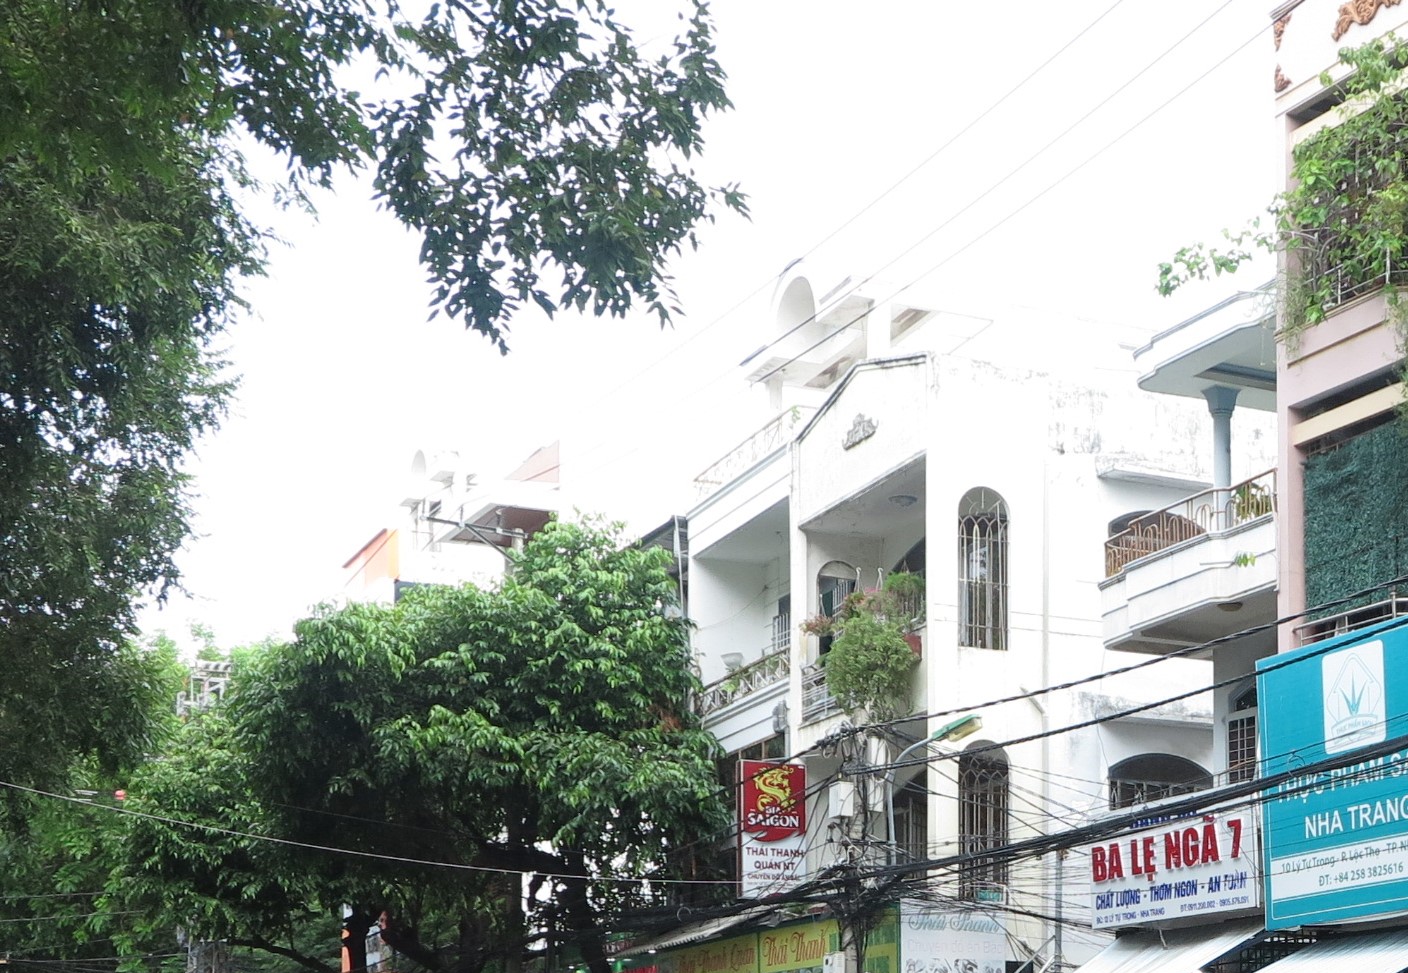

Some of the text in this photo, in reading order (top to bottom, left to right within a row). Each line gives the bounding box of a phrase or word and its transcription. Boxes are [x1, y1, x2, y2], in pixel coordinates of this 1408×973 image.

[1305, 808, 1343, 839] NHA
[1092, 843, 1123, 883] BA
[1131, 836, 1156, 882] LẸ
[1164, 815, 1219, 870] NGÃ
[1227, 819, 1242, 858] 7
[1334, 871, 1349, 883] +84
[1351, 868, 1366, 880] 258
